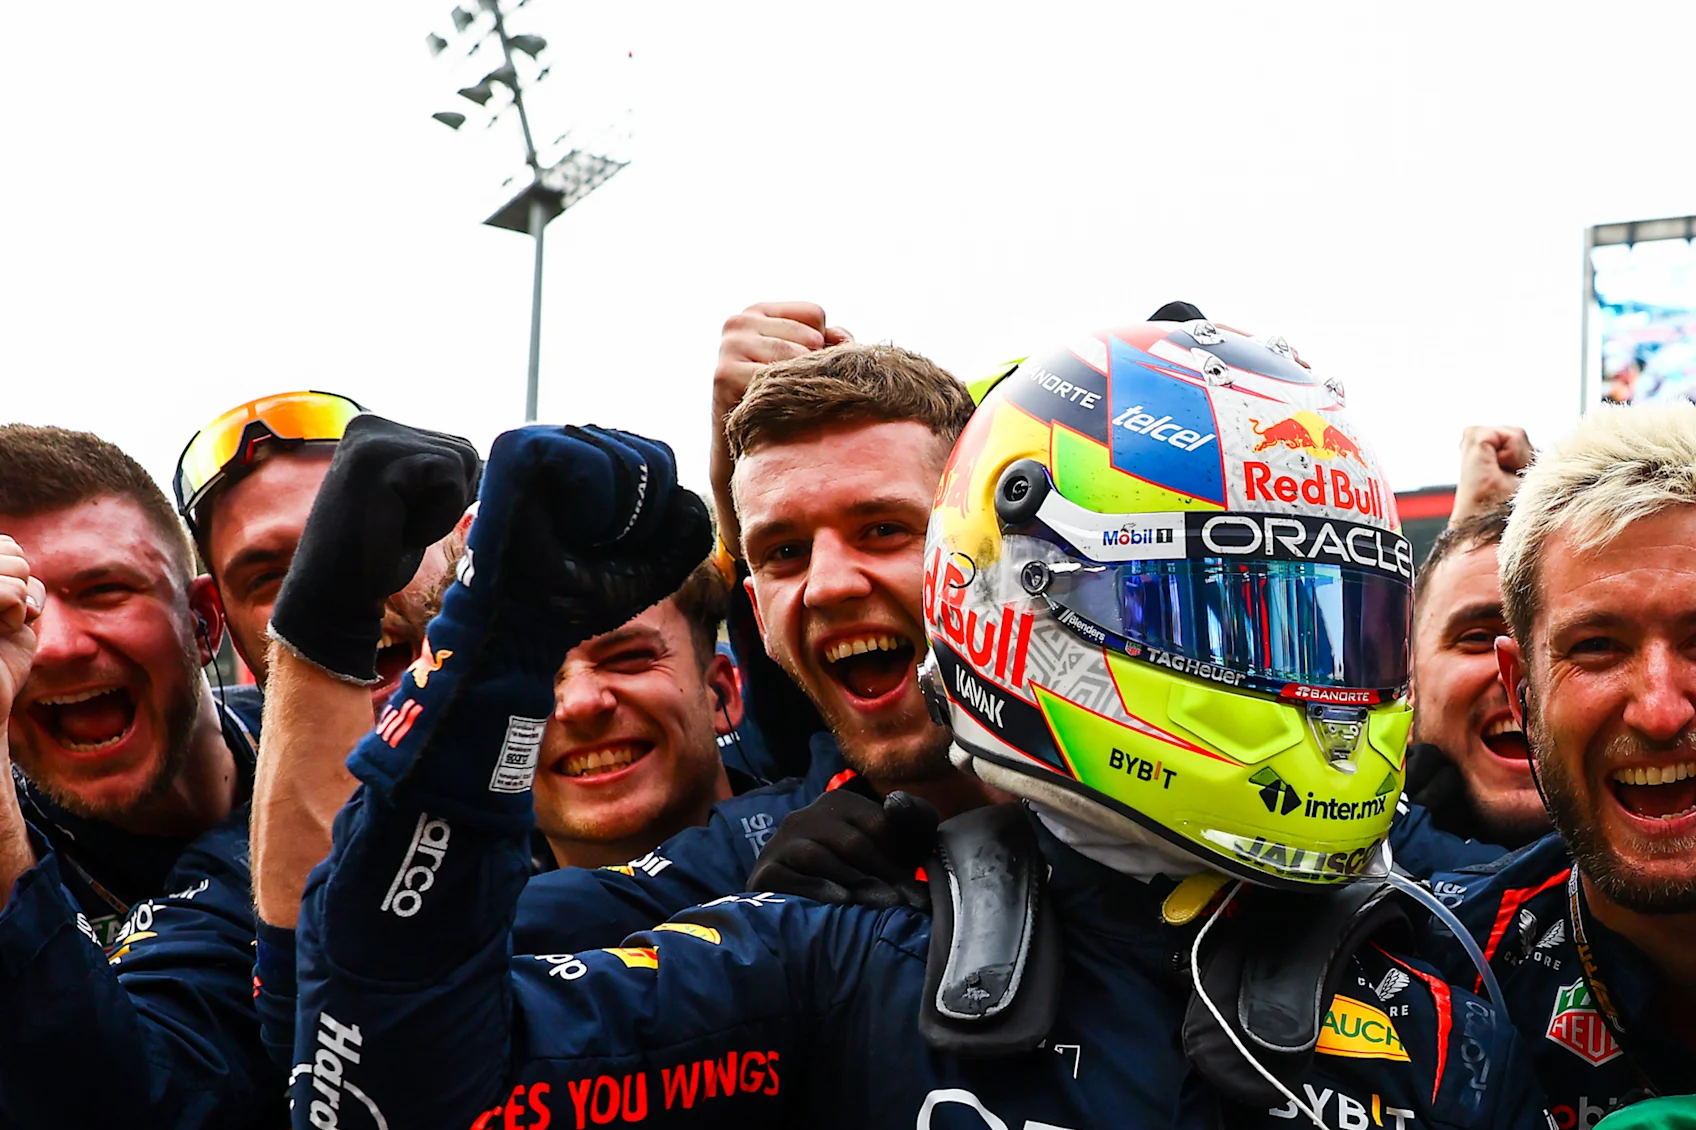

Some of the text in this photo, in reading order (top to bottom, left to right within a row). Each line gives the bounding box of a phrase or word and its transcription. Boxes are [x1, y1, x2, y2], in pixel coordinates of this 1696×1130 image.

[1030, 366, 1102, 410] ANORTE
[1112, 405, 1216, 452] telcel
[1243, 461, 1384, 520] Red Bull
[1103, 528, 1153, 546] Mobil
[1202, 515, 1413, 580] ORACLE
[1068, 613, 1106, 642] Blenders
[954, 663, 1006, 729] KAVAK
[1309, 688, 1371, 703] BANORTE
[1108, 747, 1178, 790] BYBIT
[1304, 791, 1387, 822] inter.mx
[384, 814, 452, 918] arco
[1322, 1009, 1404, 1051] AUCH
[567, 1072, 649, 1130] YOU
